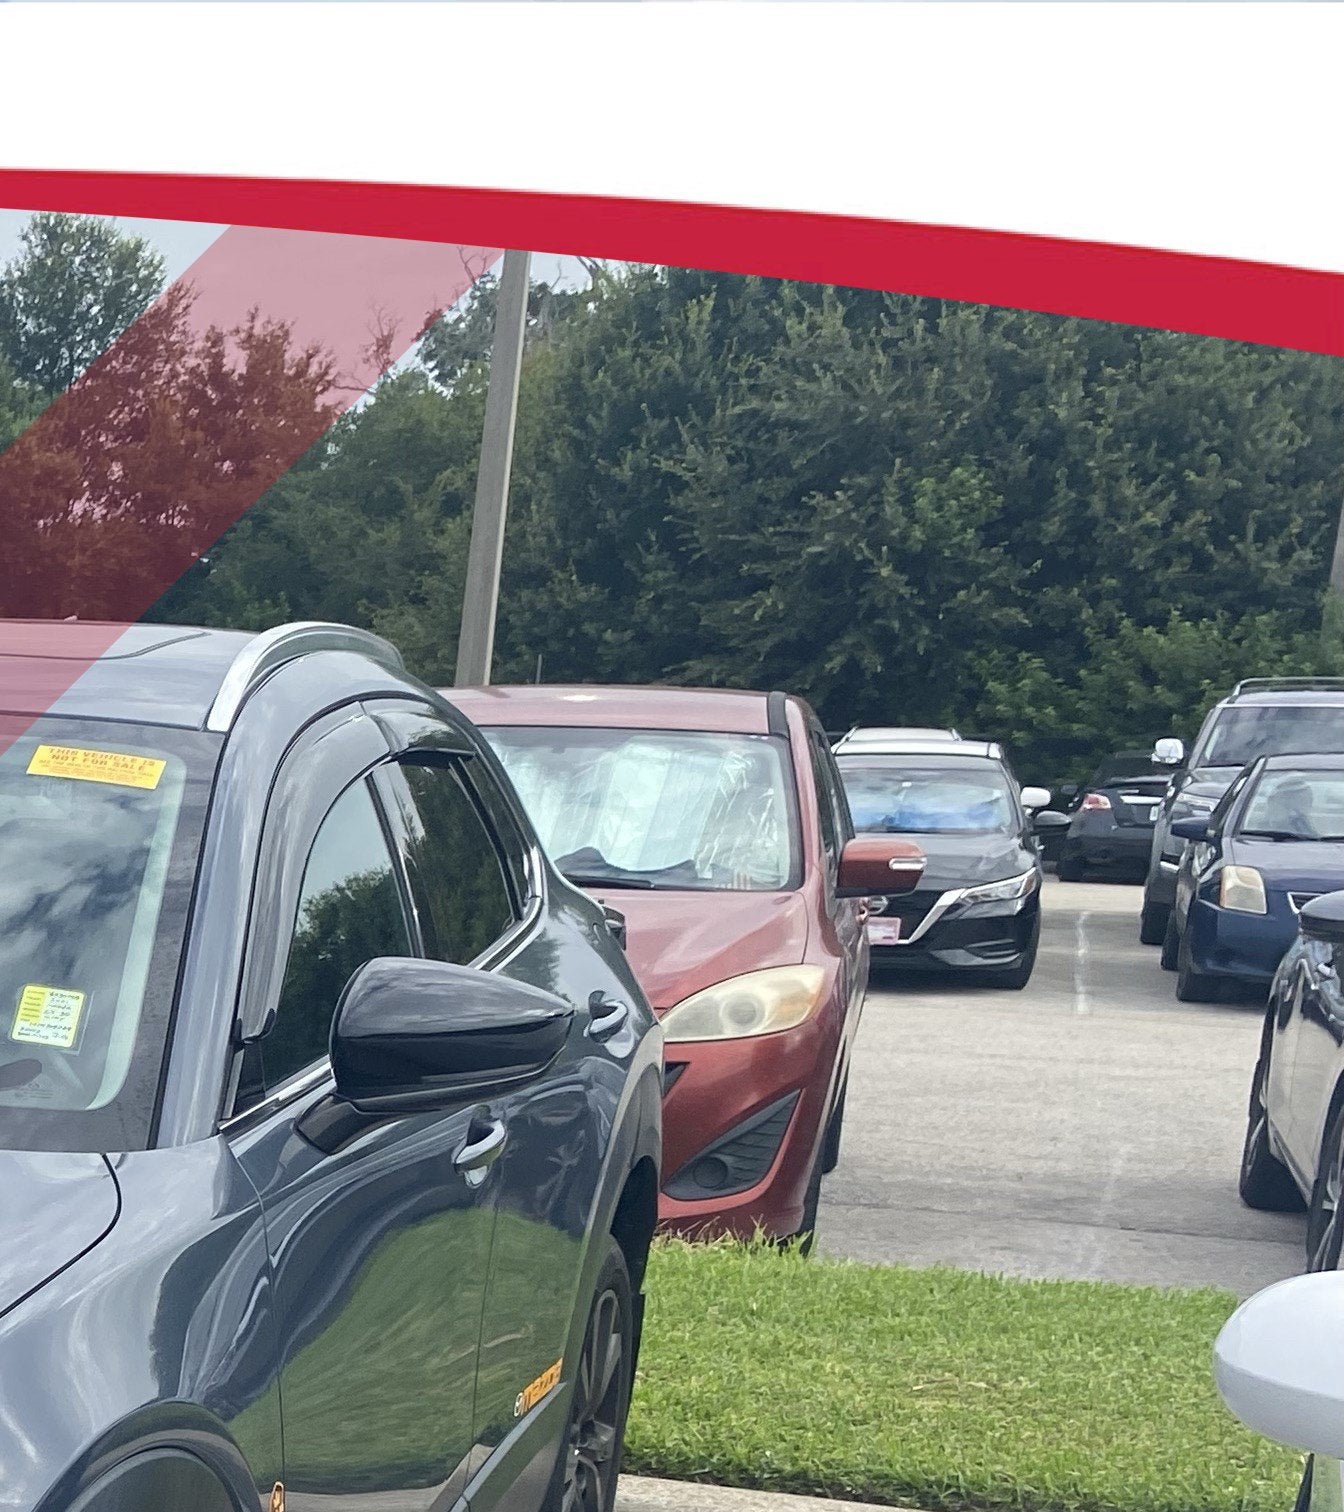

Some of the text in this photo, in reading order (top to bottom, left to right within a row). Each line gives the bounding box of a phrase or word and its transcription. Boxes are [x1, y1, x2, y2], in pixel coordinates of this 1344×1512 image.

[51, 753, 146, 772] NOT FOR SALE
